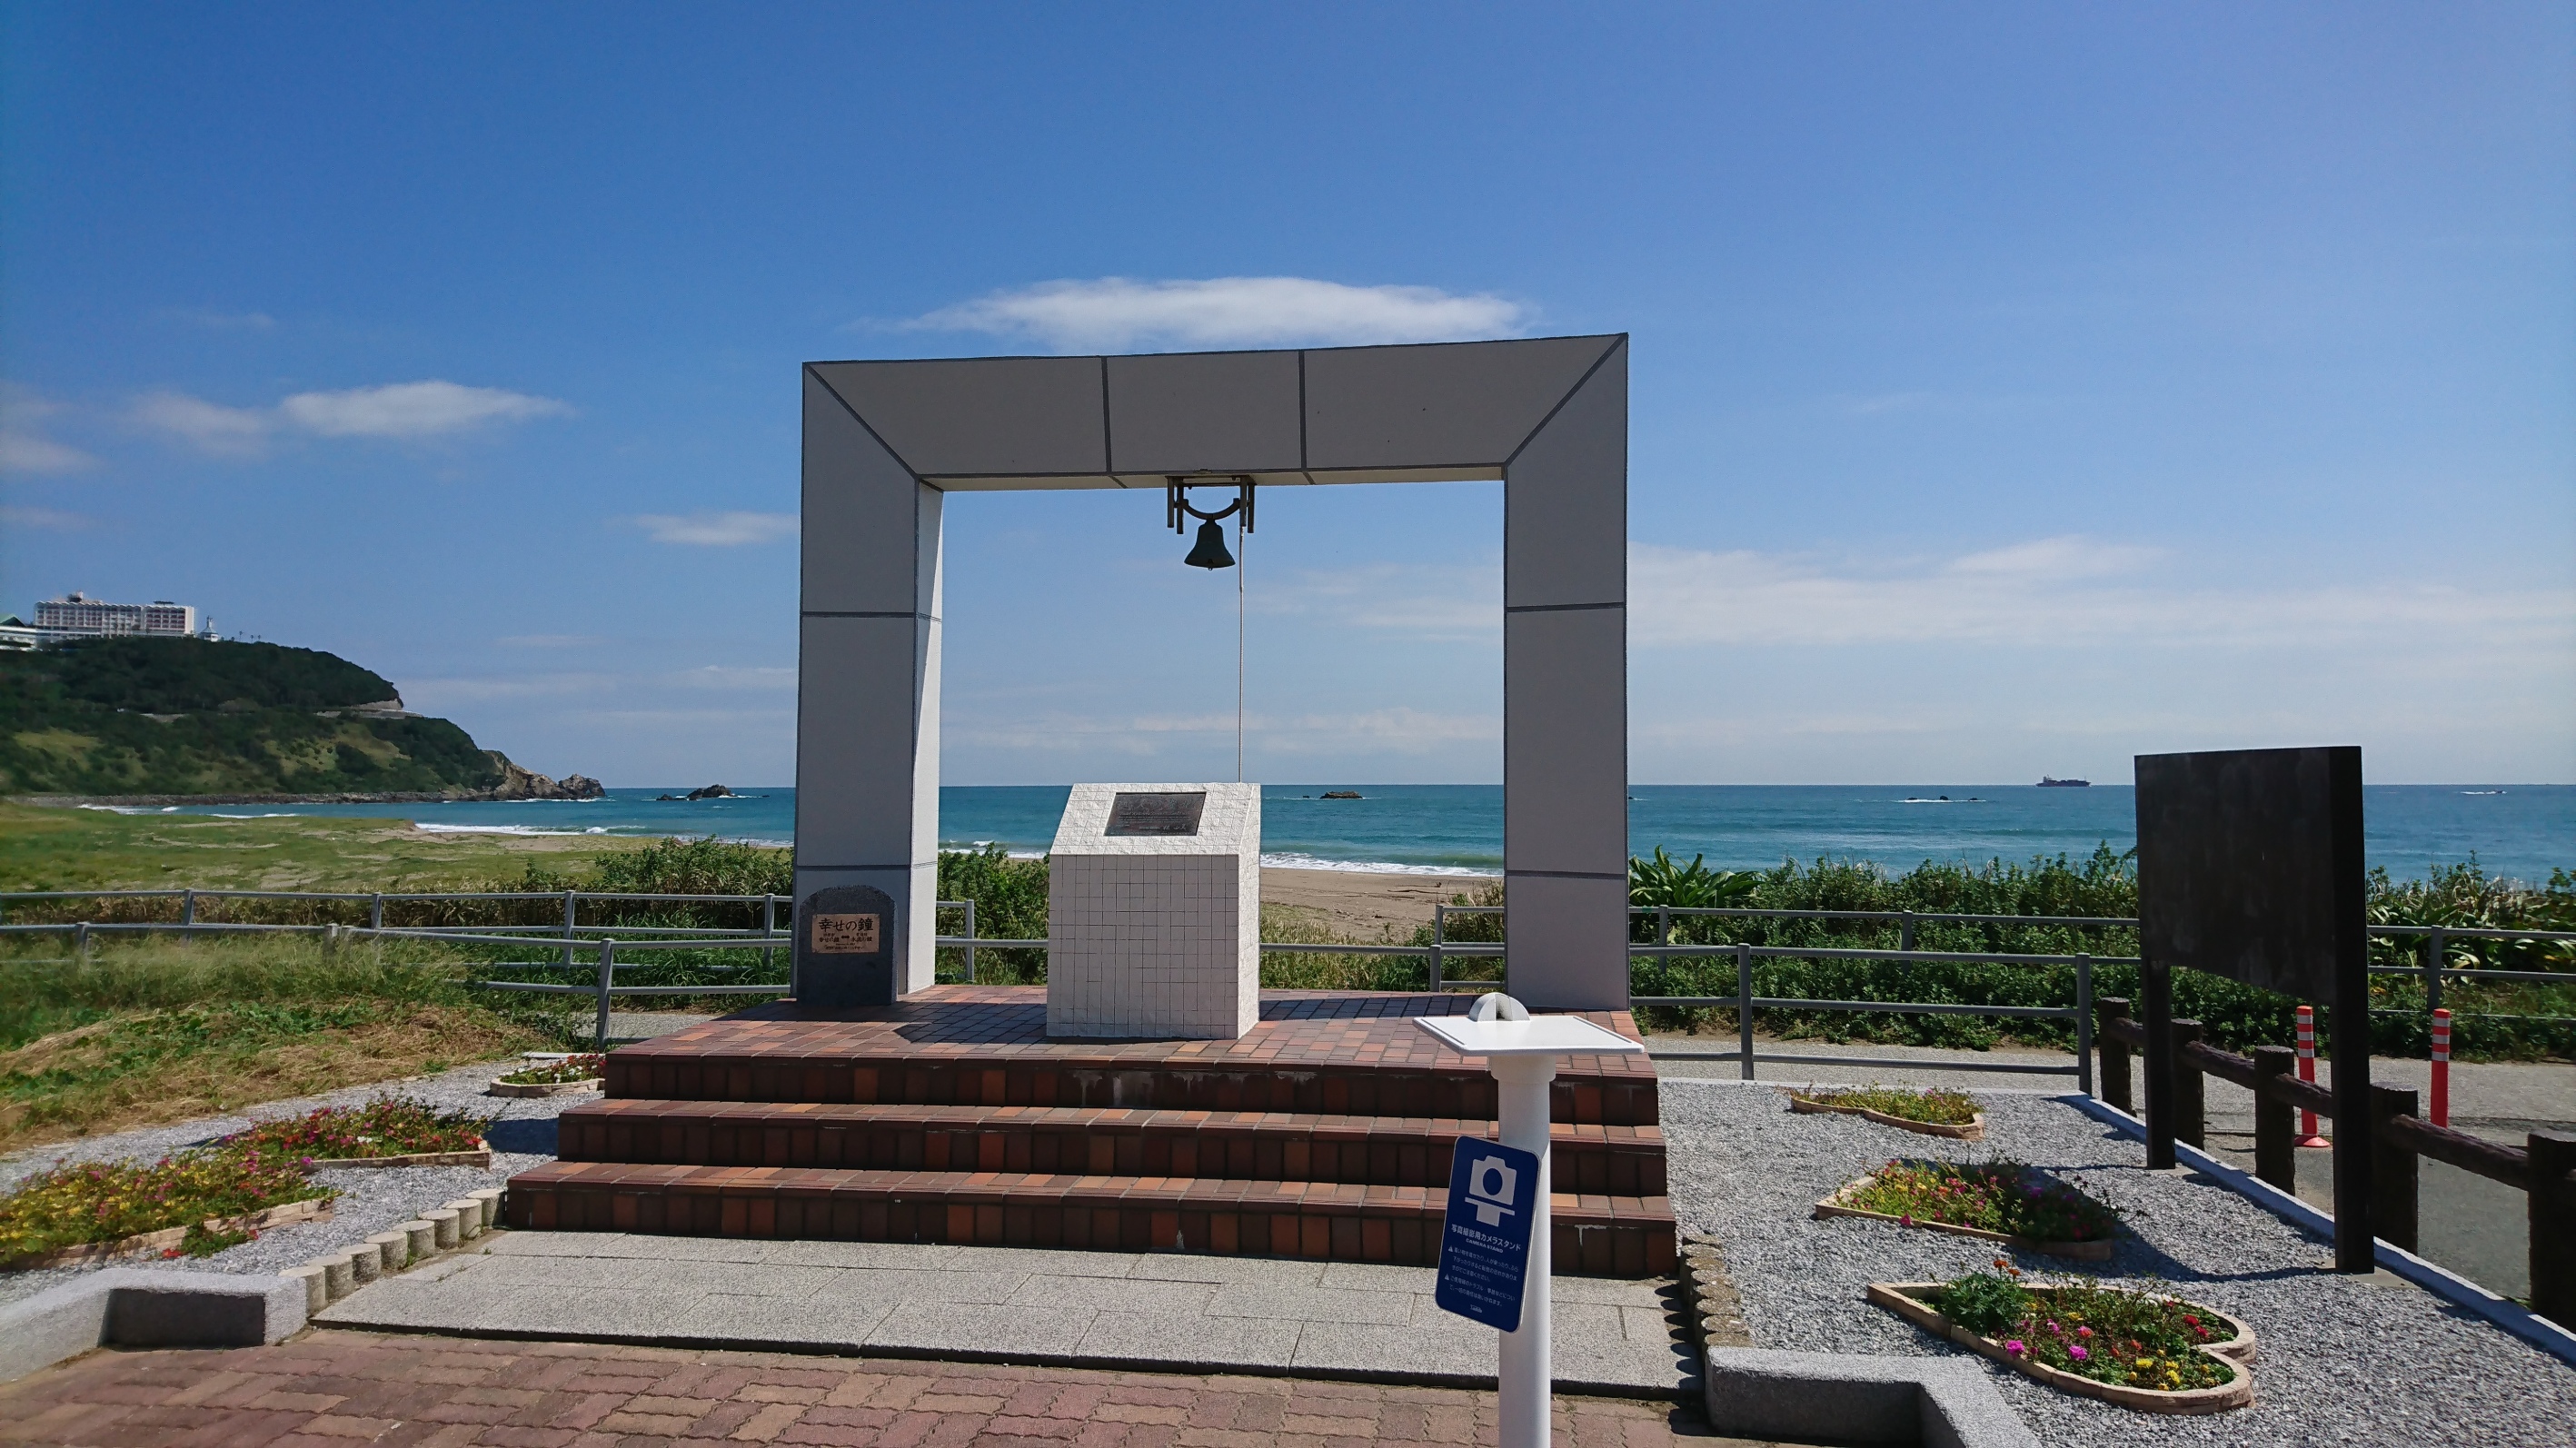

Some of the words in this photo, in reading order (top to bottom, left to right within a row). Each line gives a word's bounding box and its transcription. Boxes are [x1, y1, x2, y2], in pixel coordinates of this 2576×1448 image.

[819, 918, 873, 932] 幸せの鐘
[1451, 1224, 1520, 1251] 写真撮影用カメラスタンド
[1466, 1238, 1486, 1247] CAMERA
[1487, 1245, 1503, 1253] STAND
